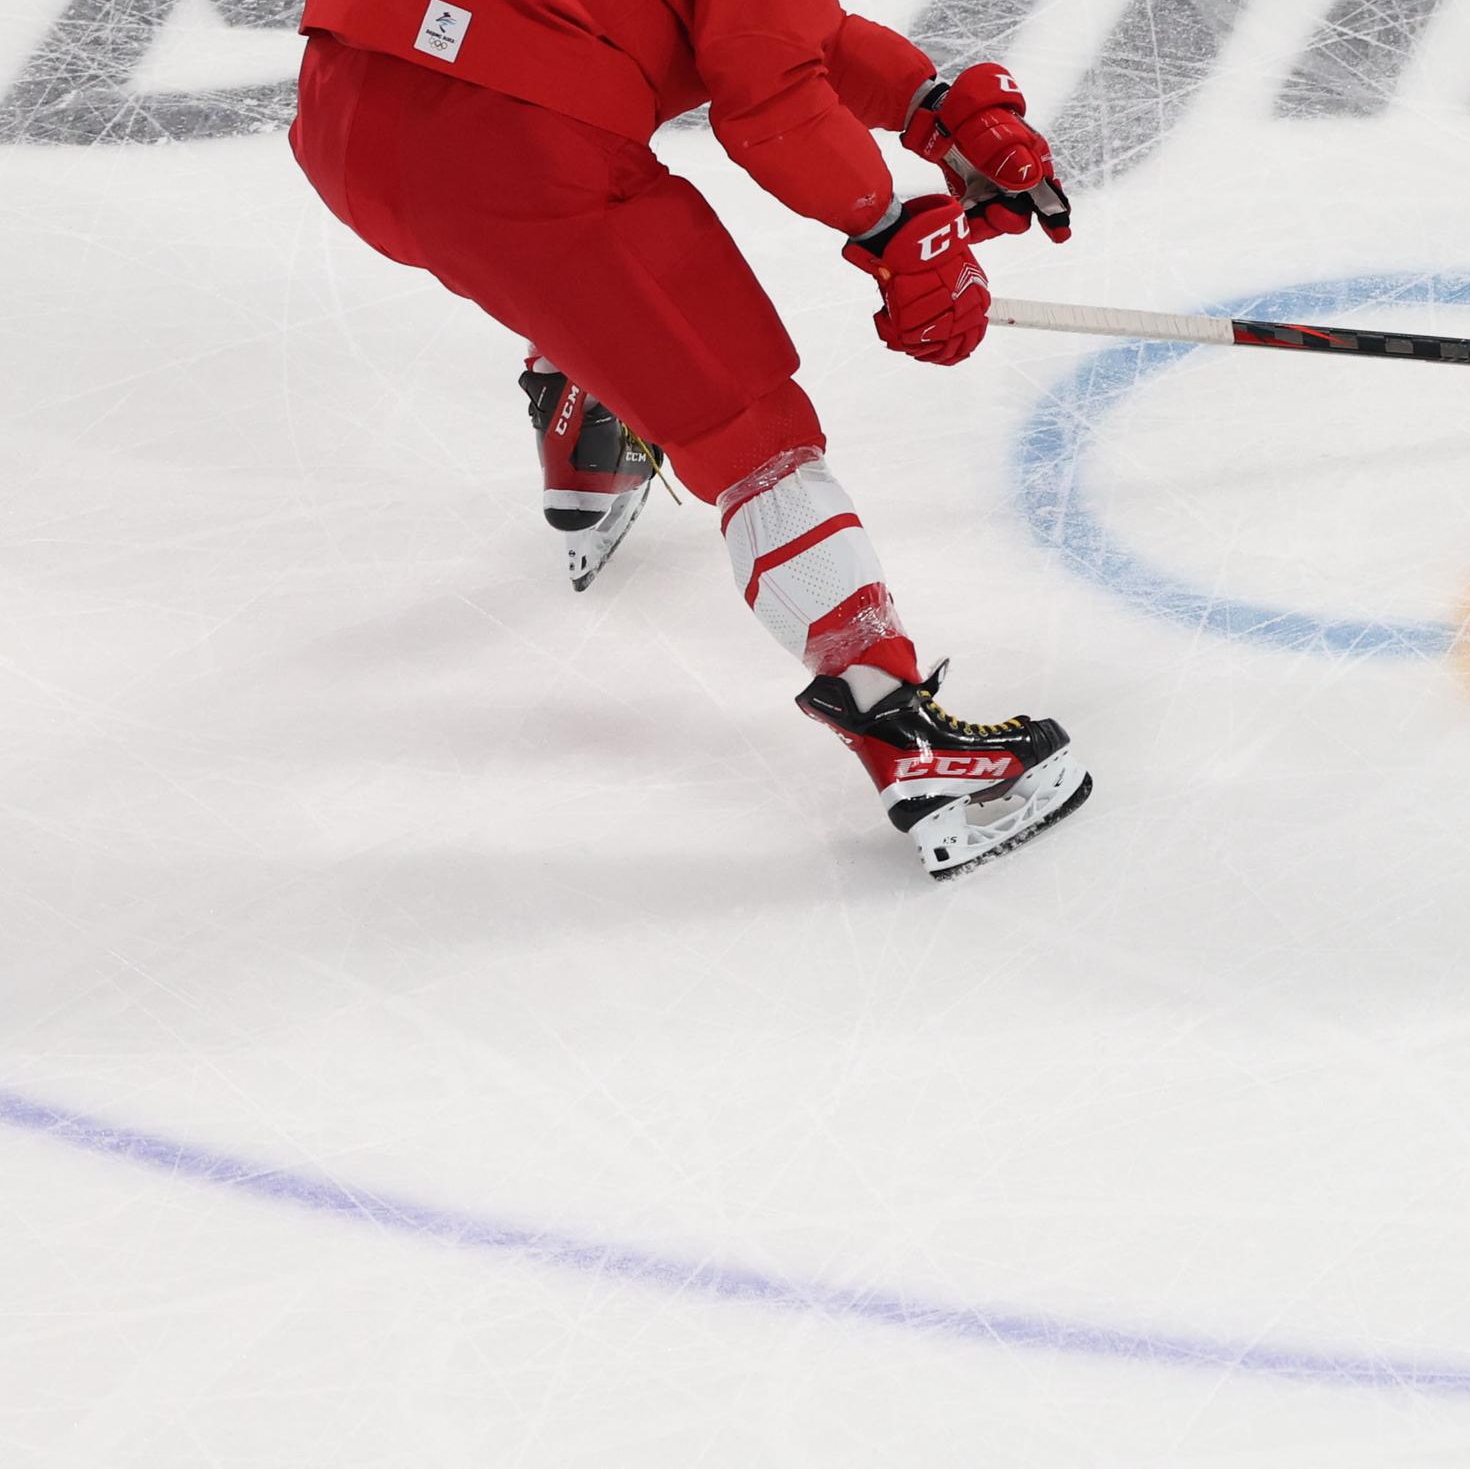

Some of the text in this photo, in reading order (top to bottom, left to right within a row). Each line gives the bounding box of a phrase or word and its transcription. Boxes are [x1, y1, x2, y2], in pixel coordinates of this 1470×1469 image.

[555, 384, 580, 436] CCM
[625, 450, 647, 463] CCM
[894, 756, 1013, 778] CCM
